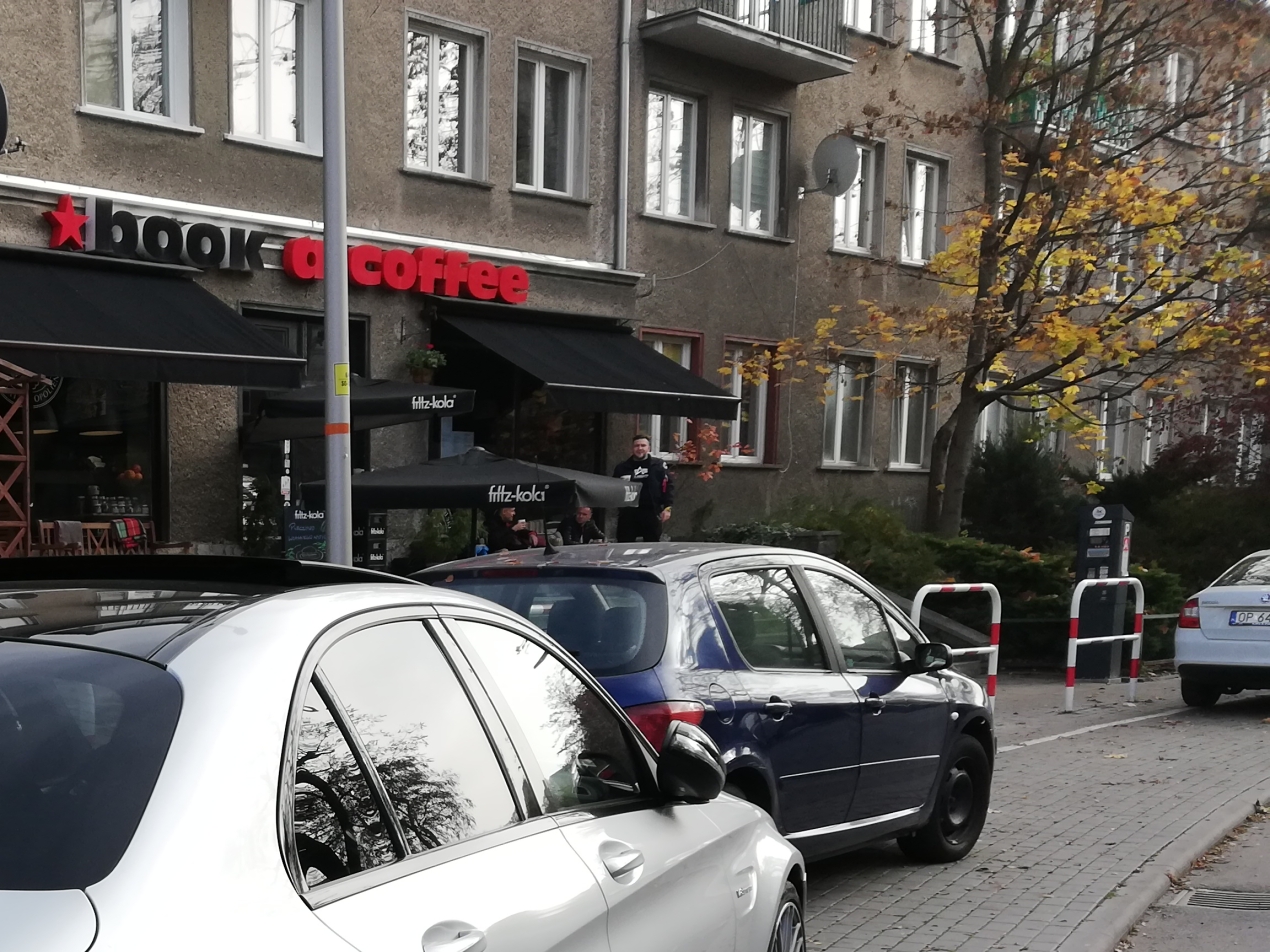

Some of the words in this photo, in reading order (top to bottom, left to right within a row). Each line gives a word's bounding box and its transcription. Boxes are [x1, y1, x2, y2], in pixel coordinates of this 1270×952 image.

[87, 197, 267, 272] book
[347, 245, 529, 304] coffee
[412, 395, 454, 410] fritz-kola
[1238, 612, 1253, 623] OP
